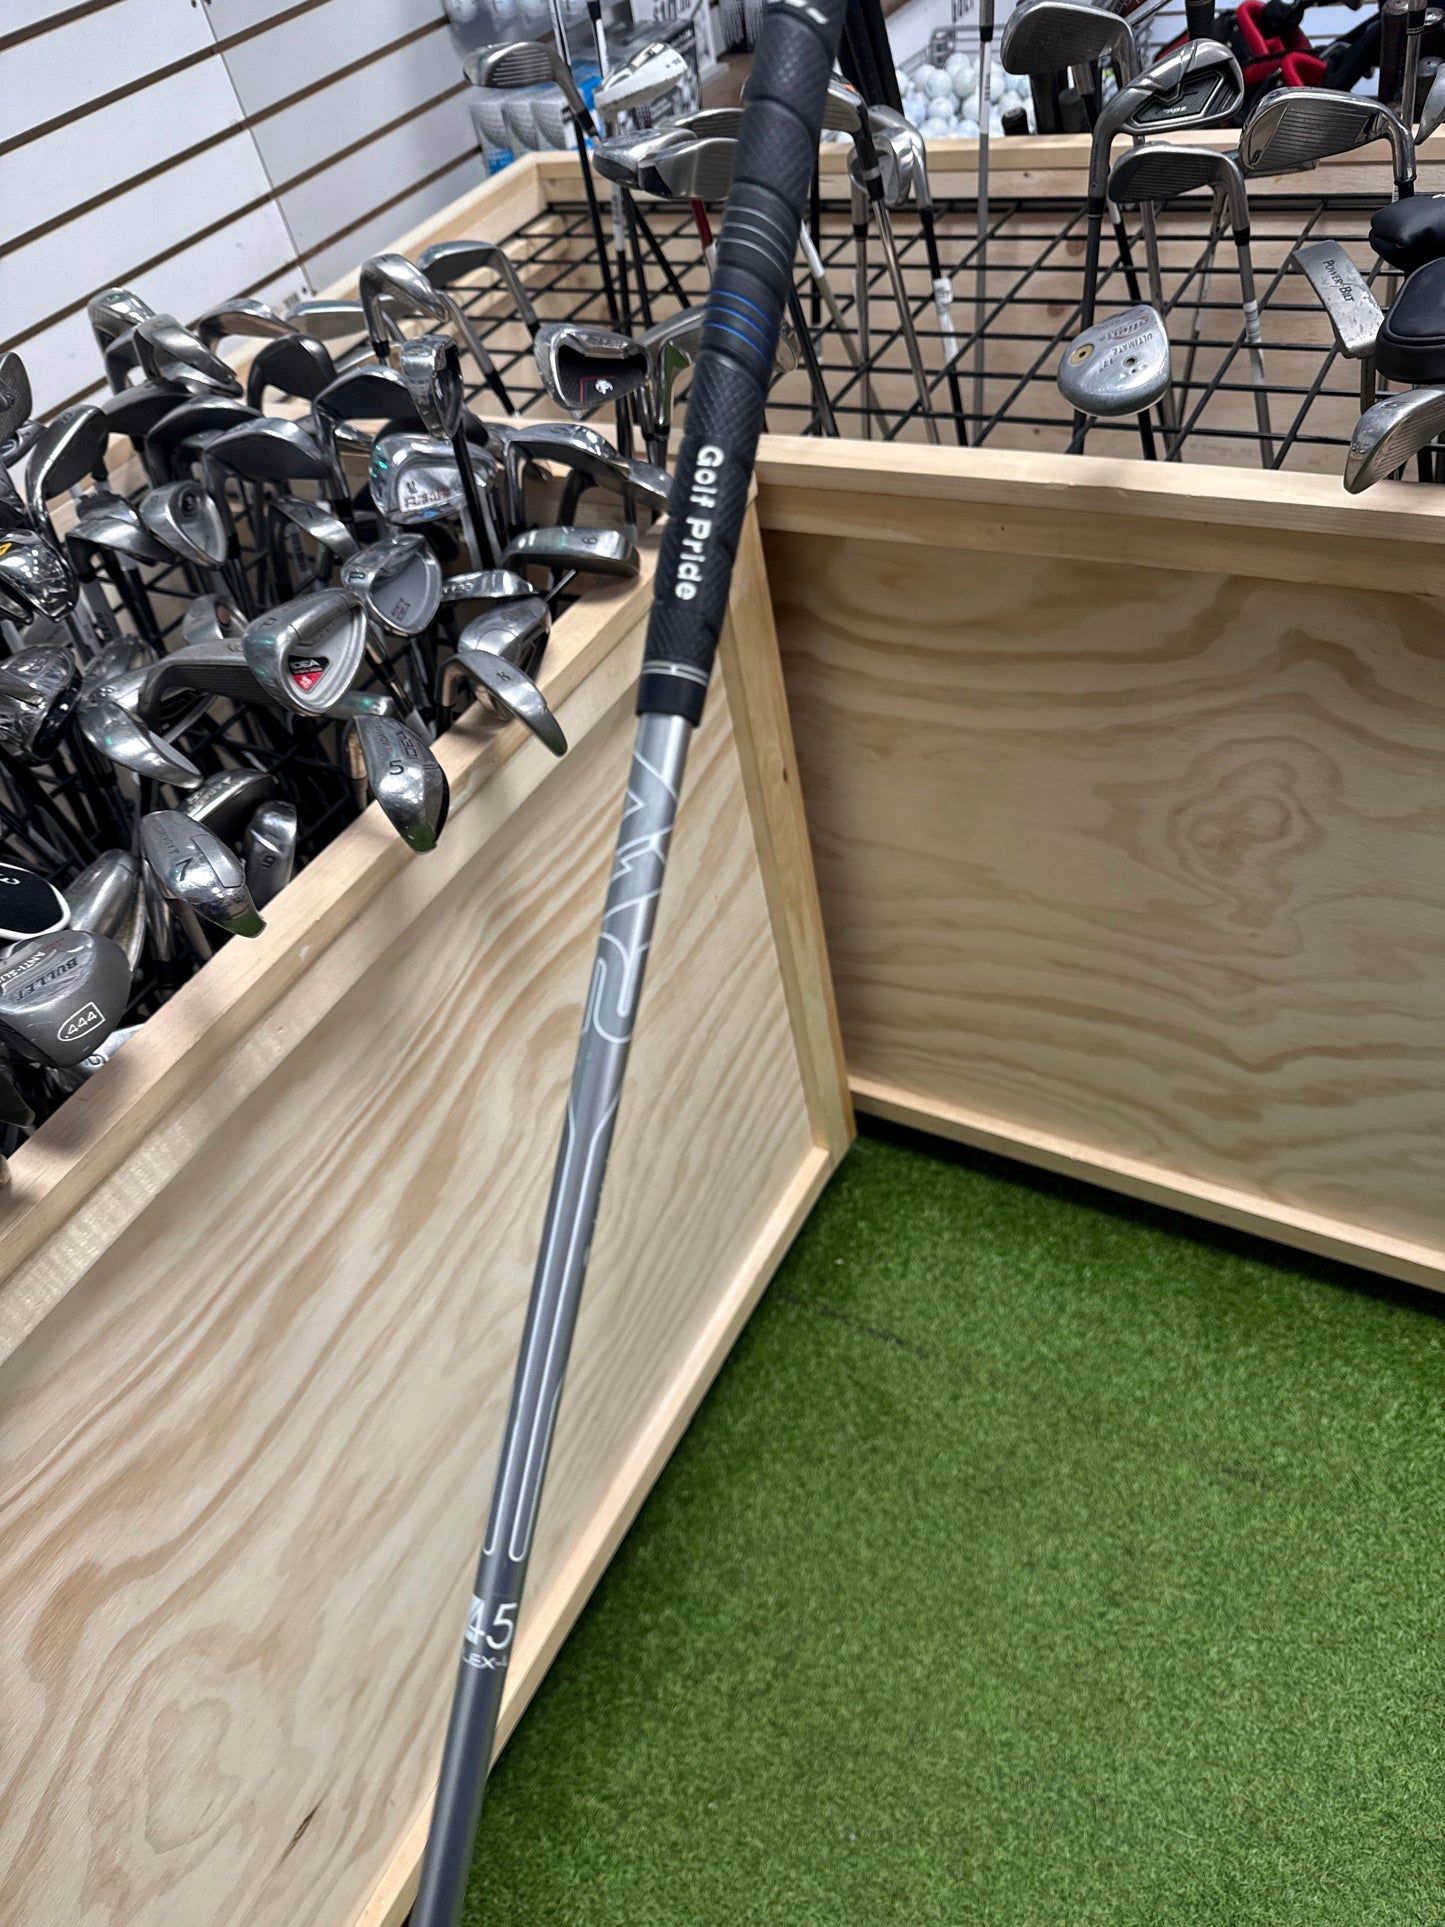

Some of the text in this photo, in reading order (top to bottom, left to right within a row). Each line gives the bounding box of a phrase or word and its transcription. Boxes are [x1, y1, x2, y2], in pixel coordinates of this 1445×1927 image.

[1112, 333, 1153, 356] ULTIMATE
[675, 445, 724, 600] Golf Pride
[389, 760, 404, 775] 5
[176, 857, 193, 881] 7
[17, 957, 79, 1001] BULLET
[65, 1011, 98, 1039] .444
